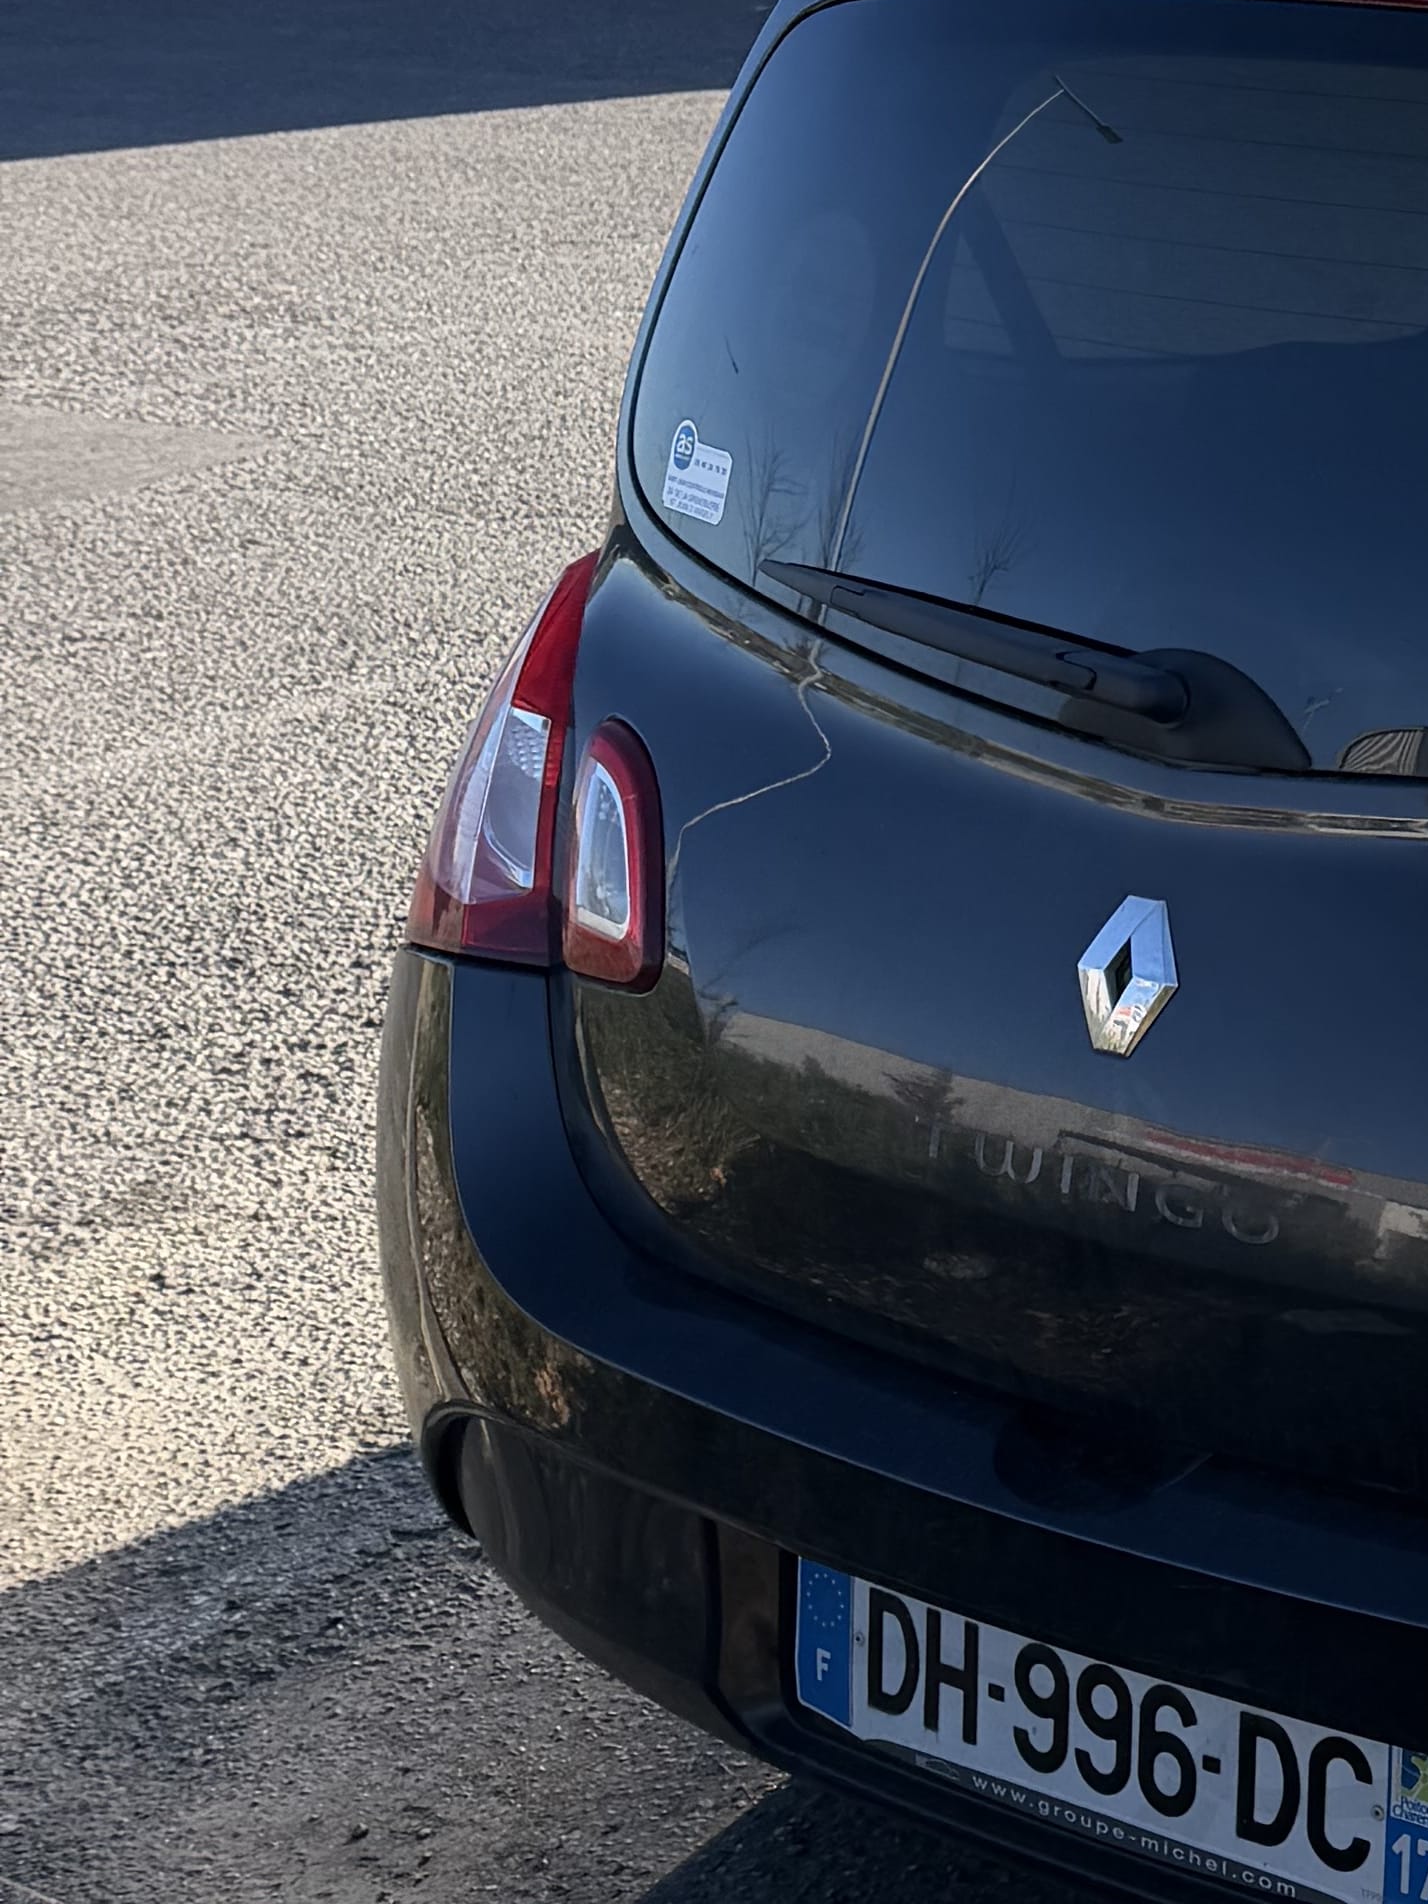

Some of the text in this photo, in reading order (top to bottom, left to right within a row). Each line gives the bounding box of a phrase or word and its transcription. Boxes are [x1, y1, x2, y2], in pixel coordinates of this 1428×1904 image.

[914, 1112, 1280, 1246] TWINGO
[815, 1646, 832, 1682] F
[866, 1586, 1374, 1872] DH-996-DC
[972, 1774, 1298, 1898] www.groupe-michel.com
